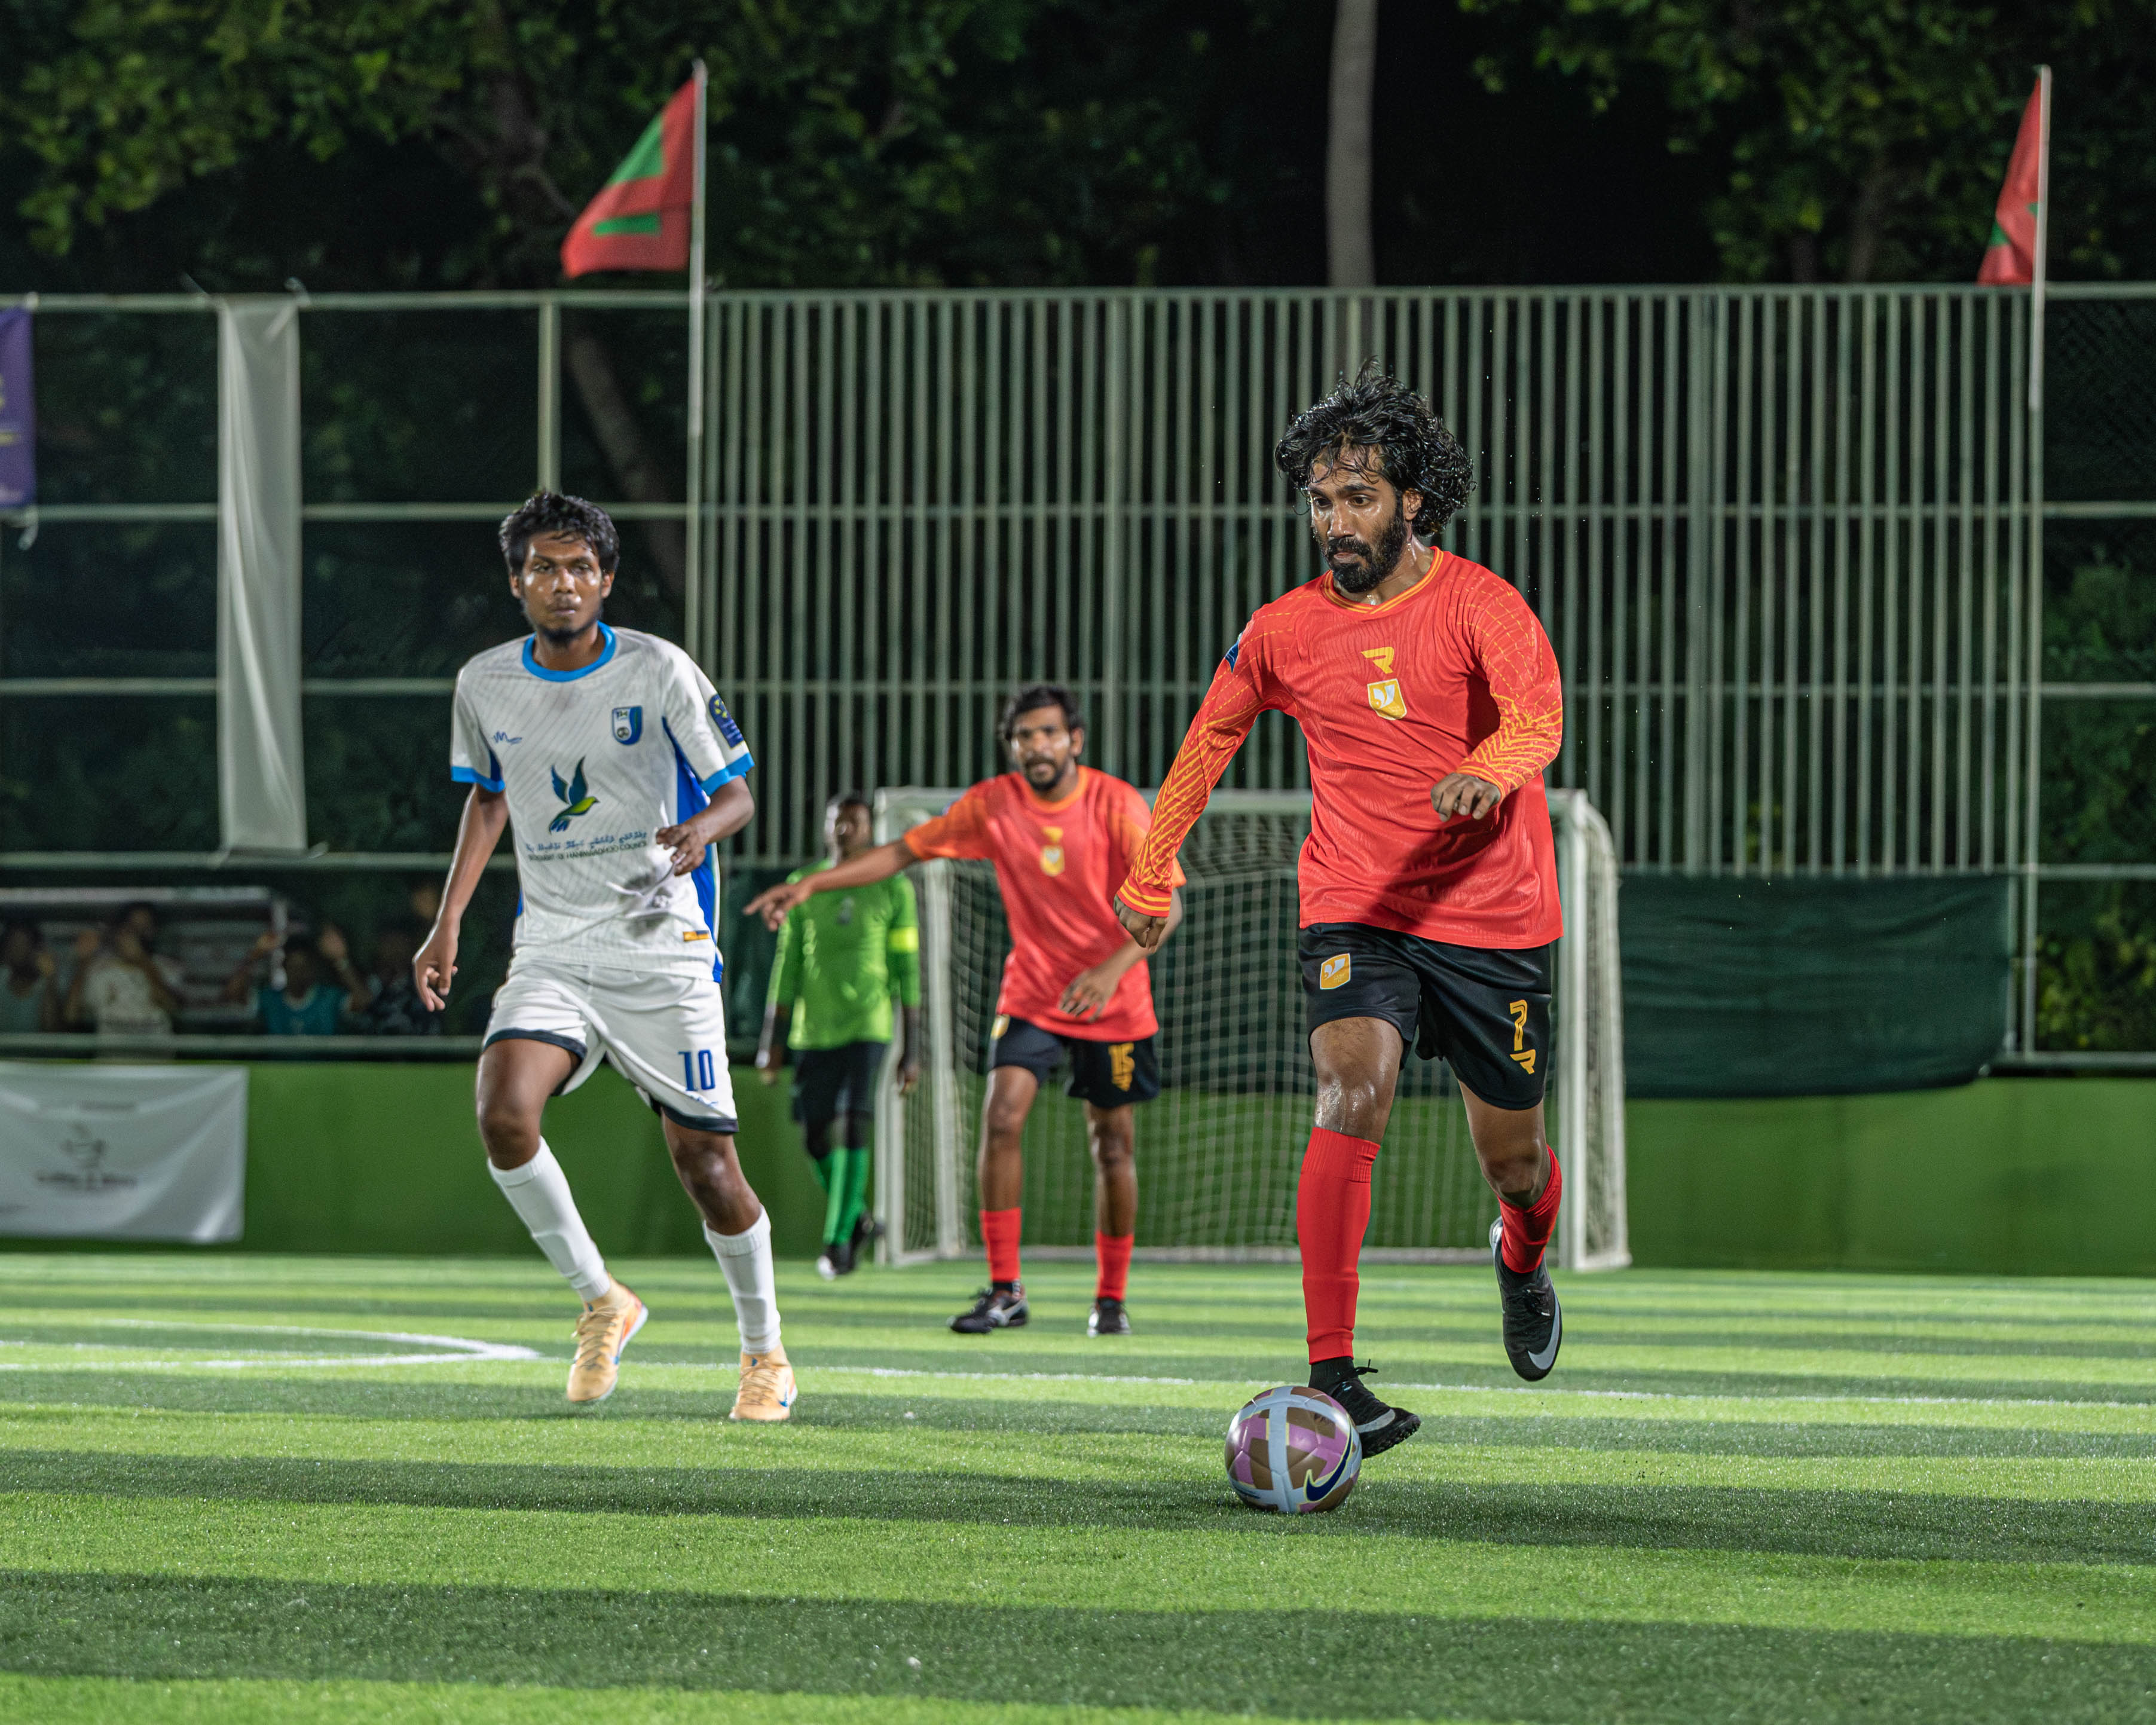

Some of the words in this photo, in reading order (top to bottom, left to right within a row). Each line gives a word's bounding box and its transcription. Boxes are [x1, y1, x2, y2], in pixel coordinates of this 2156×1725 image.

[1509, 999, 1528, 1051] 7
[677, 1050, 715, 1091] 10
[1108, 1042, 1135, 1076] 15
